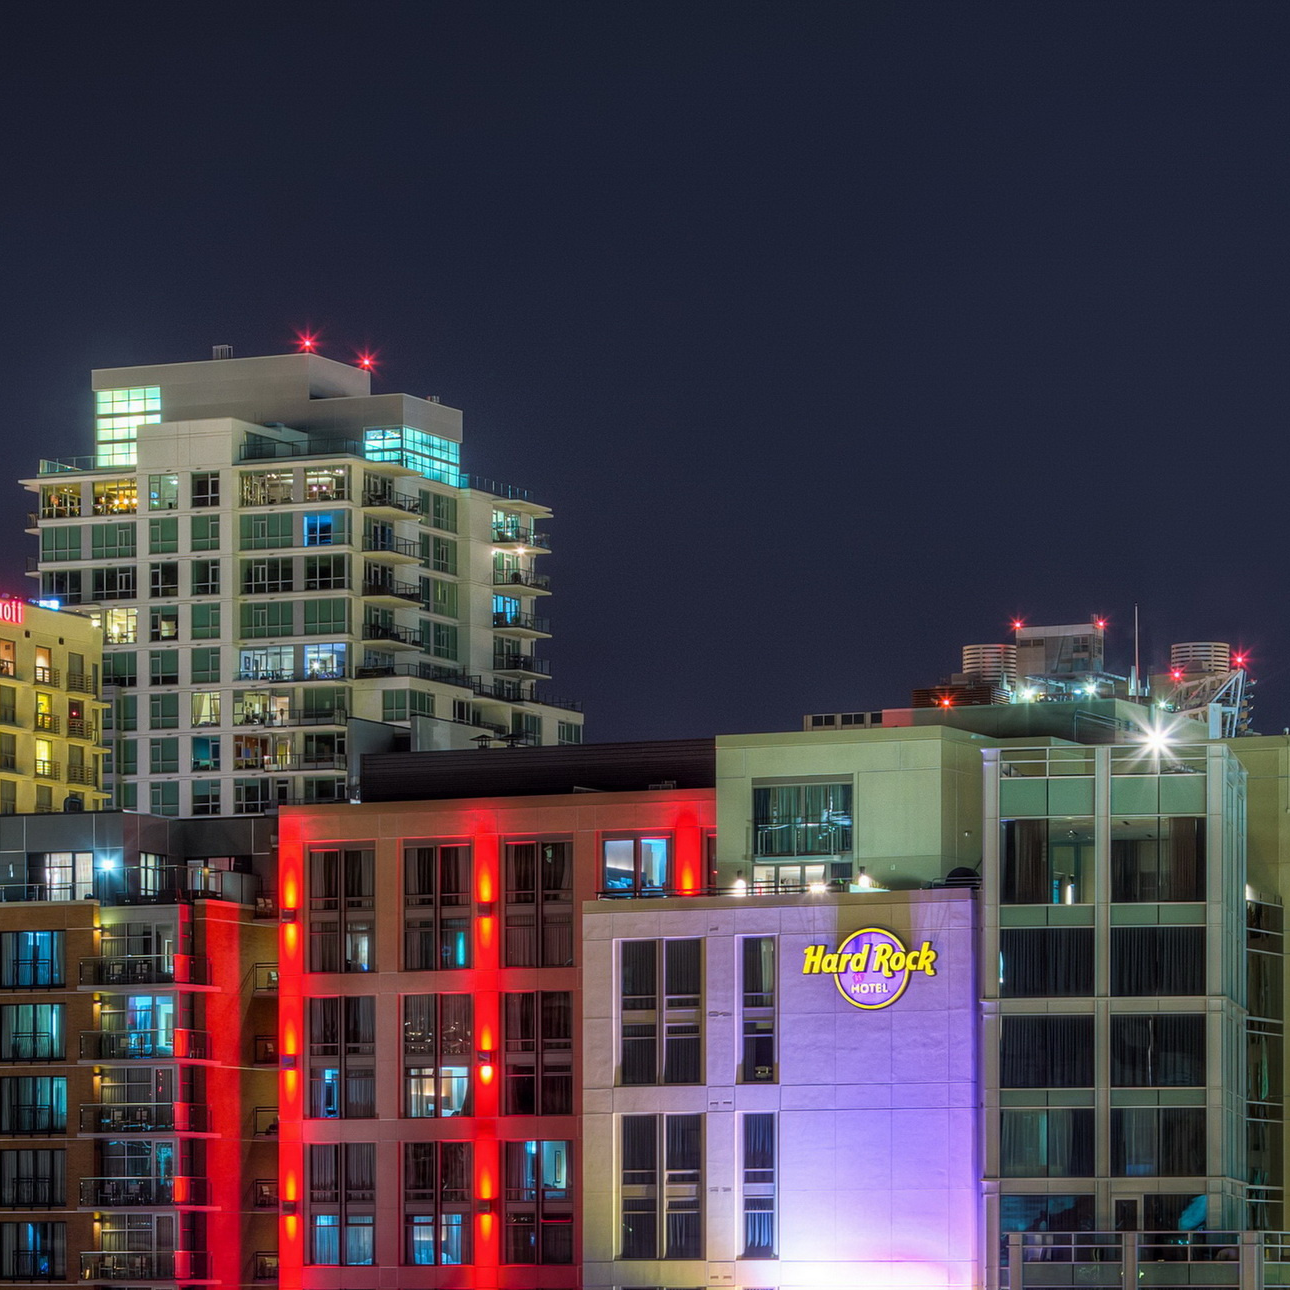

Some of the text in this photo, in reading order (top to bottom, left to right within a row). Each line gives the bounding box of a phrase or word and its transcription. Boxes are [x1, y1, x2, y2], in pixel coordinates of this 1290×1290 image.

[802, 941, 937, 978] Hard Rock
[851, 983, 889, 994] HOTEL
